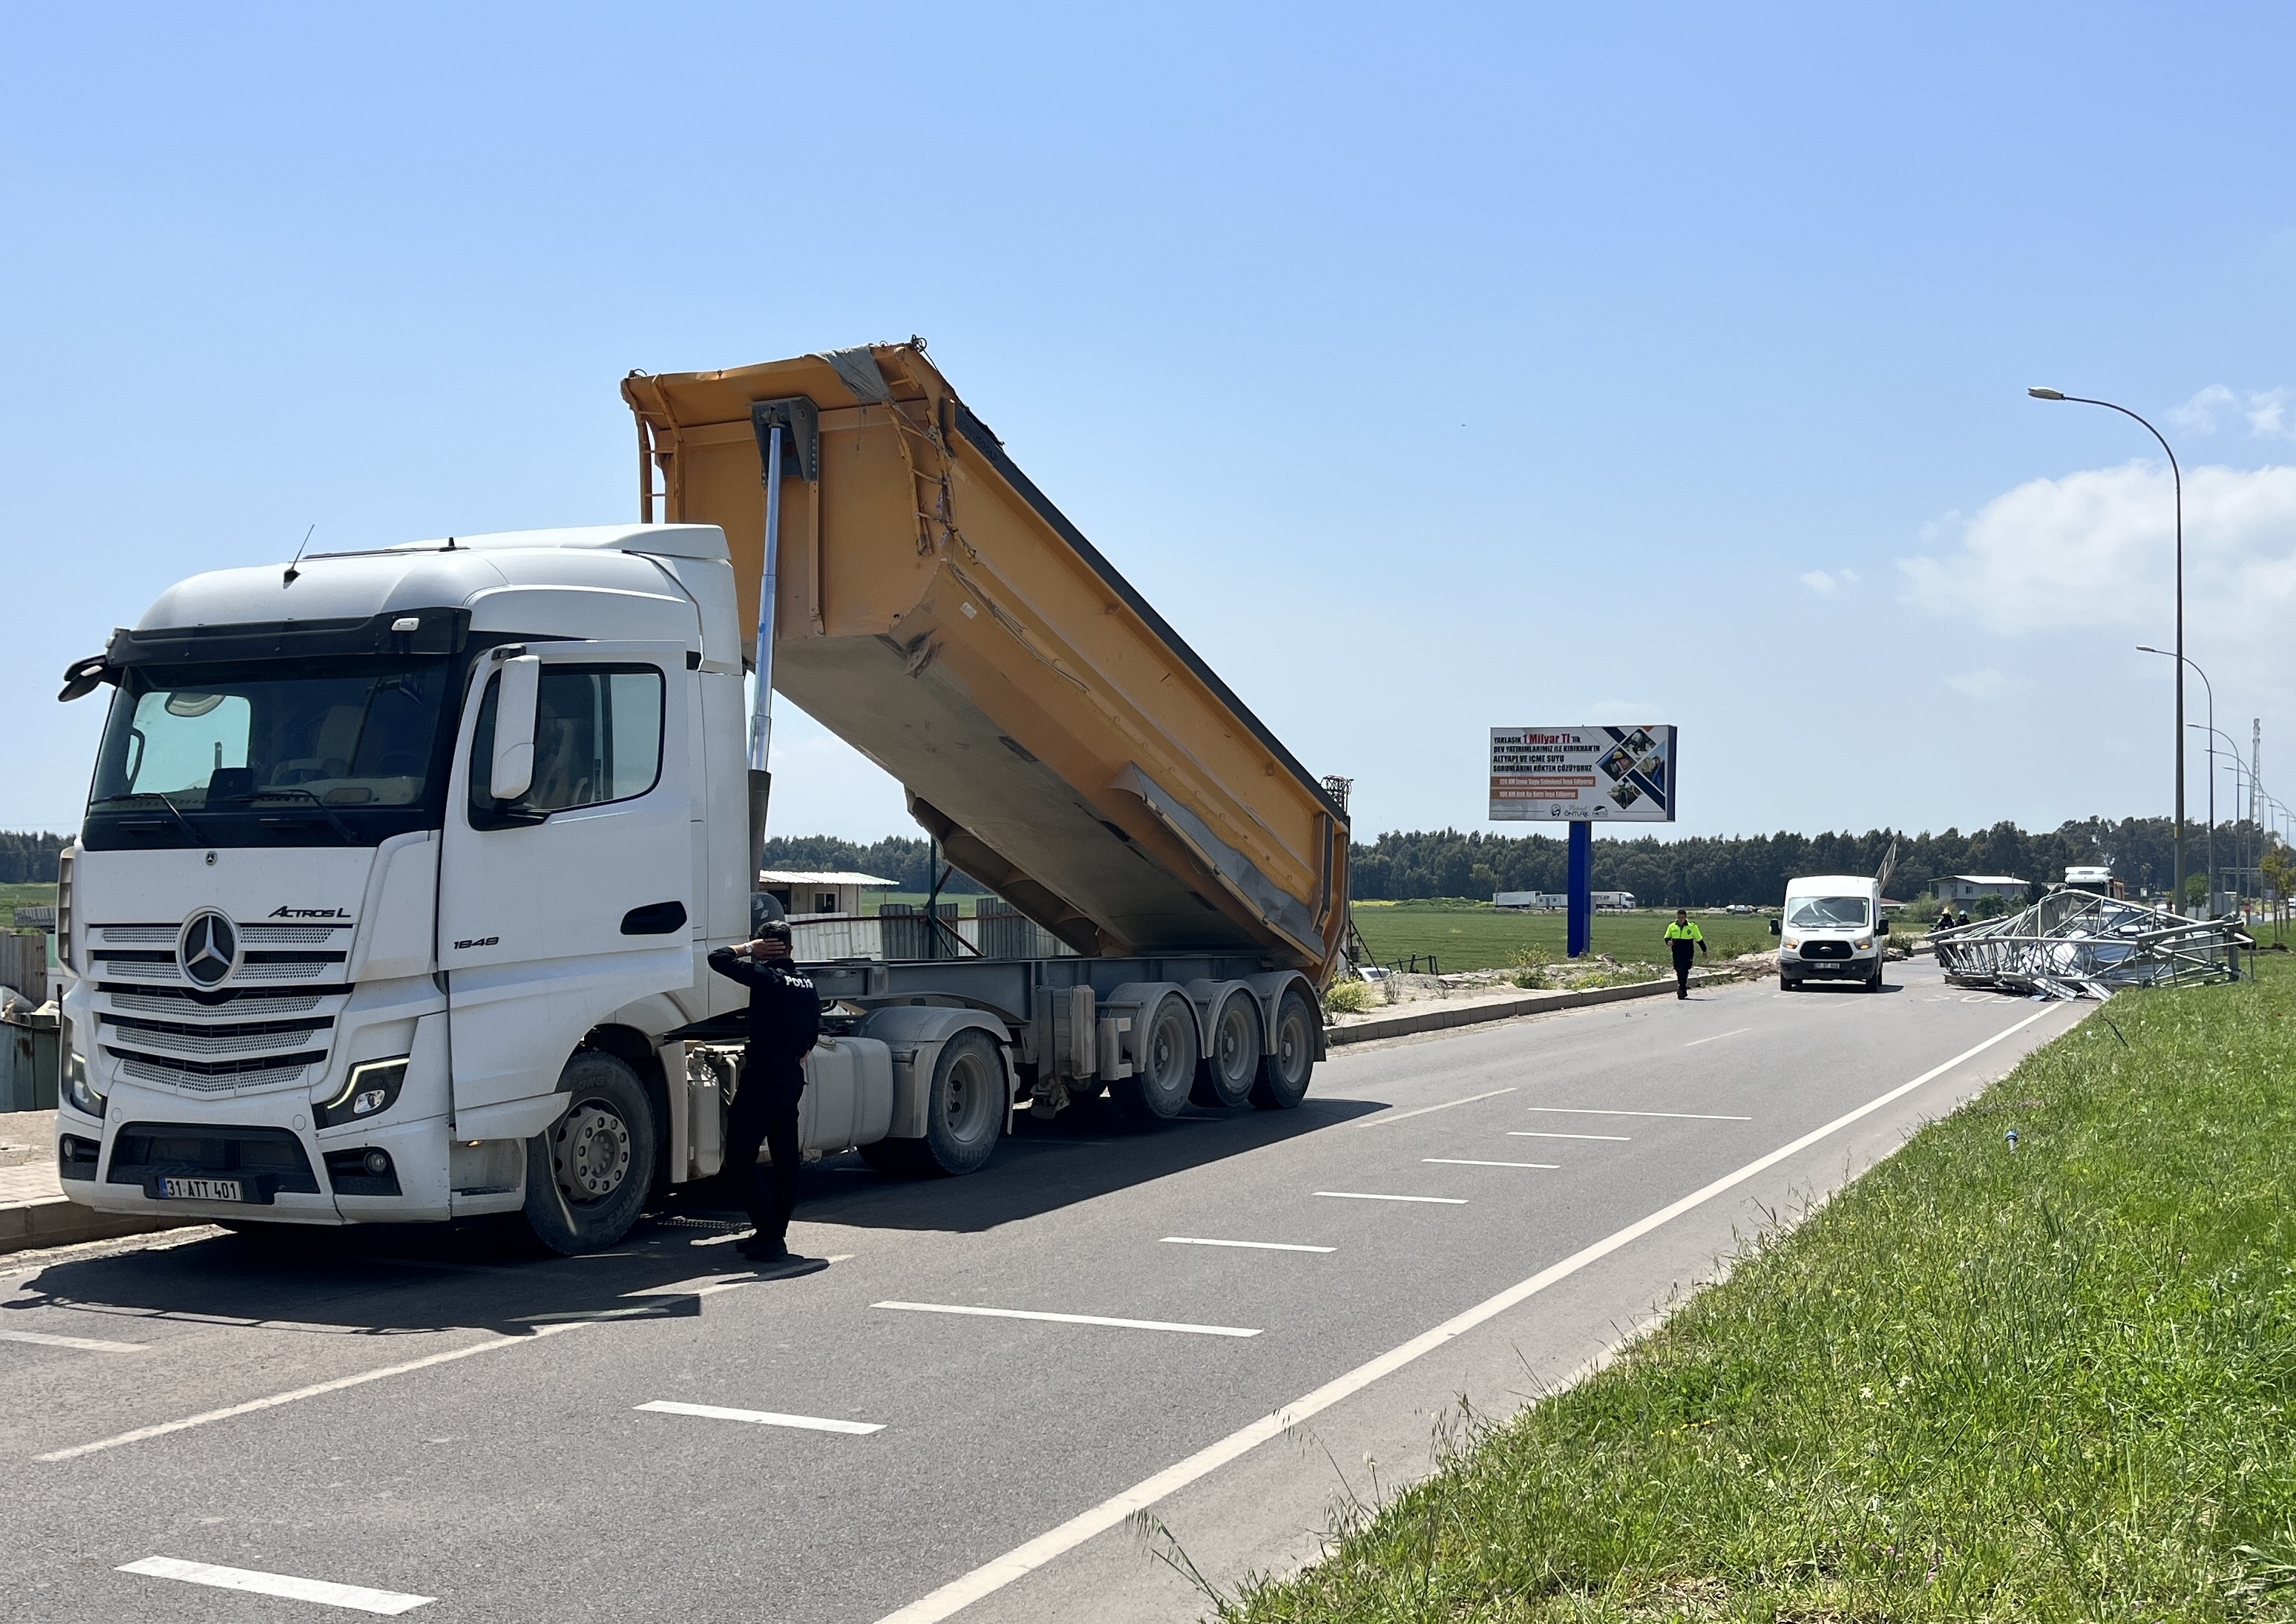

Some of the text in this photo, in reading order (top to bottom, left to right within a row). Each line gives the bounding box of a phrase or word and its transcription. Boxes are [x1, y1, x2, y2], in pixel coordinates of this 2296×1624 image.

[1529, 734, 1560, 744] Milyar
[336, 907, 351, 918] L
[453, 936, 499, 950] 1848
[167, 1180, 236, 1199] 31 ATT 401
